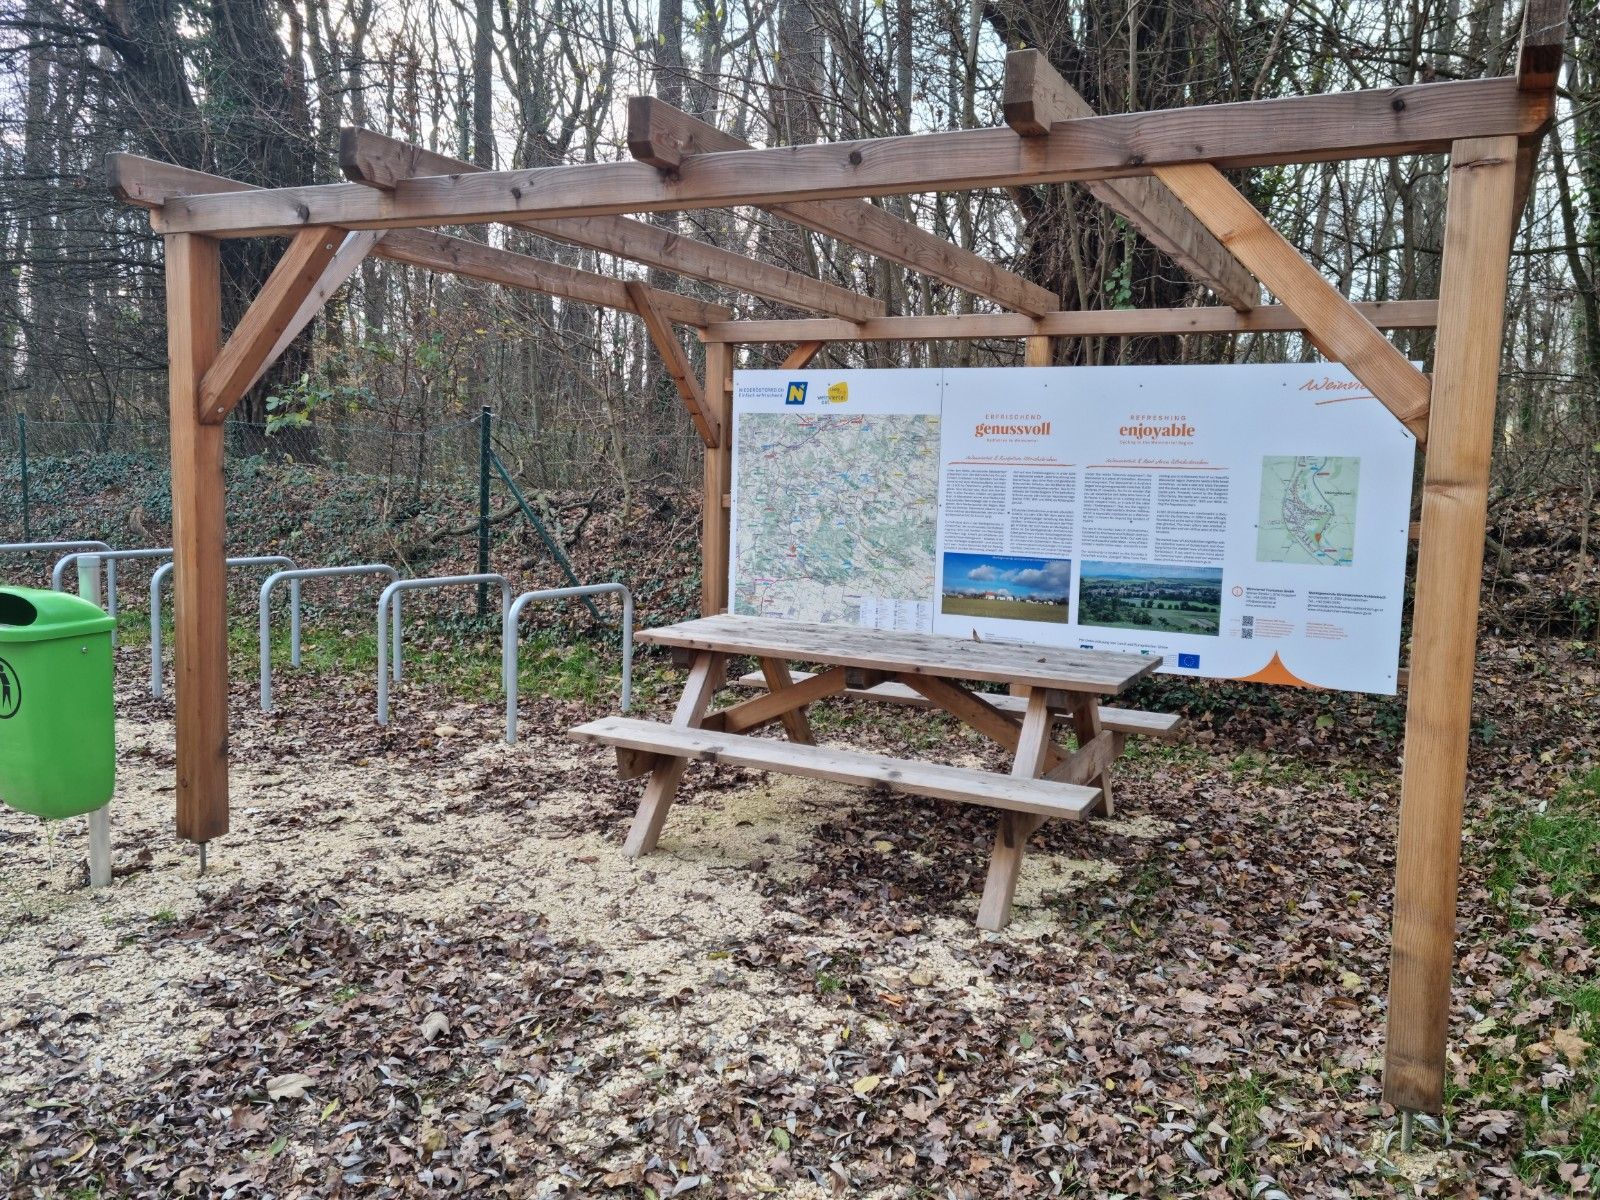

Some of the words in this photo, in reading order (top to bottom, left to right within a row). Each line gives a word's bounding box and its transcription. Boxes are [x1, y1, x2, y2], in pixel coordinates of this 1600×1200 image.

[788, 385, 804, 402] N
[975, 422, 1051, 438] genussvoll
[1119, 423, 1196, 440] enjoyable
